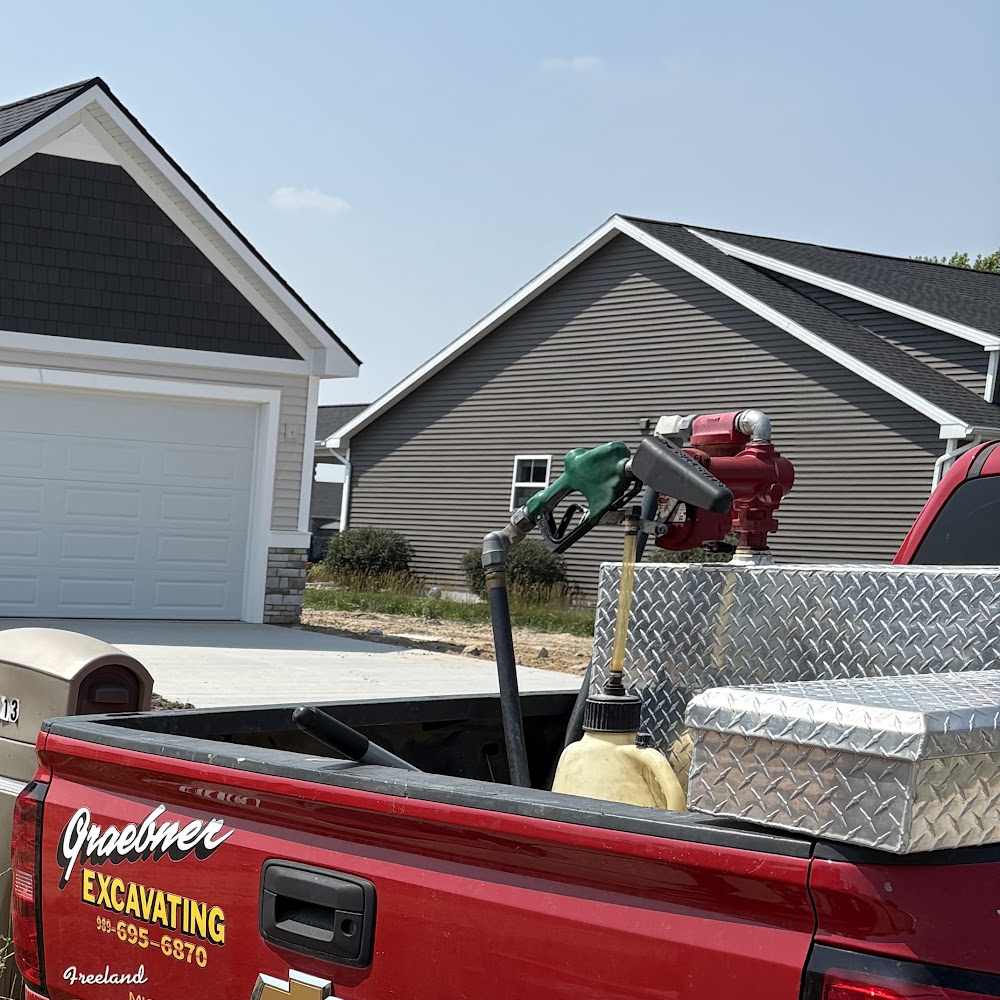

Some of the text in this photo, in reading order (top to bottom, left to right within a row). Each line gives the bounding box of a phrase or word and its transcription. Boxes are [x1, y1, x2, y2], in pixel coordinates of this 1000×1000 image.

[57, 804, 235, 890] Graebner
[81, 867, 226, 947] EXCAVATING
[63, 964, 148, 985] Freeland
[96, 915, 208, 968] 989-695-6870
